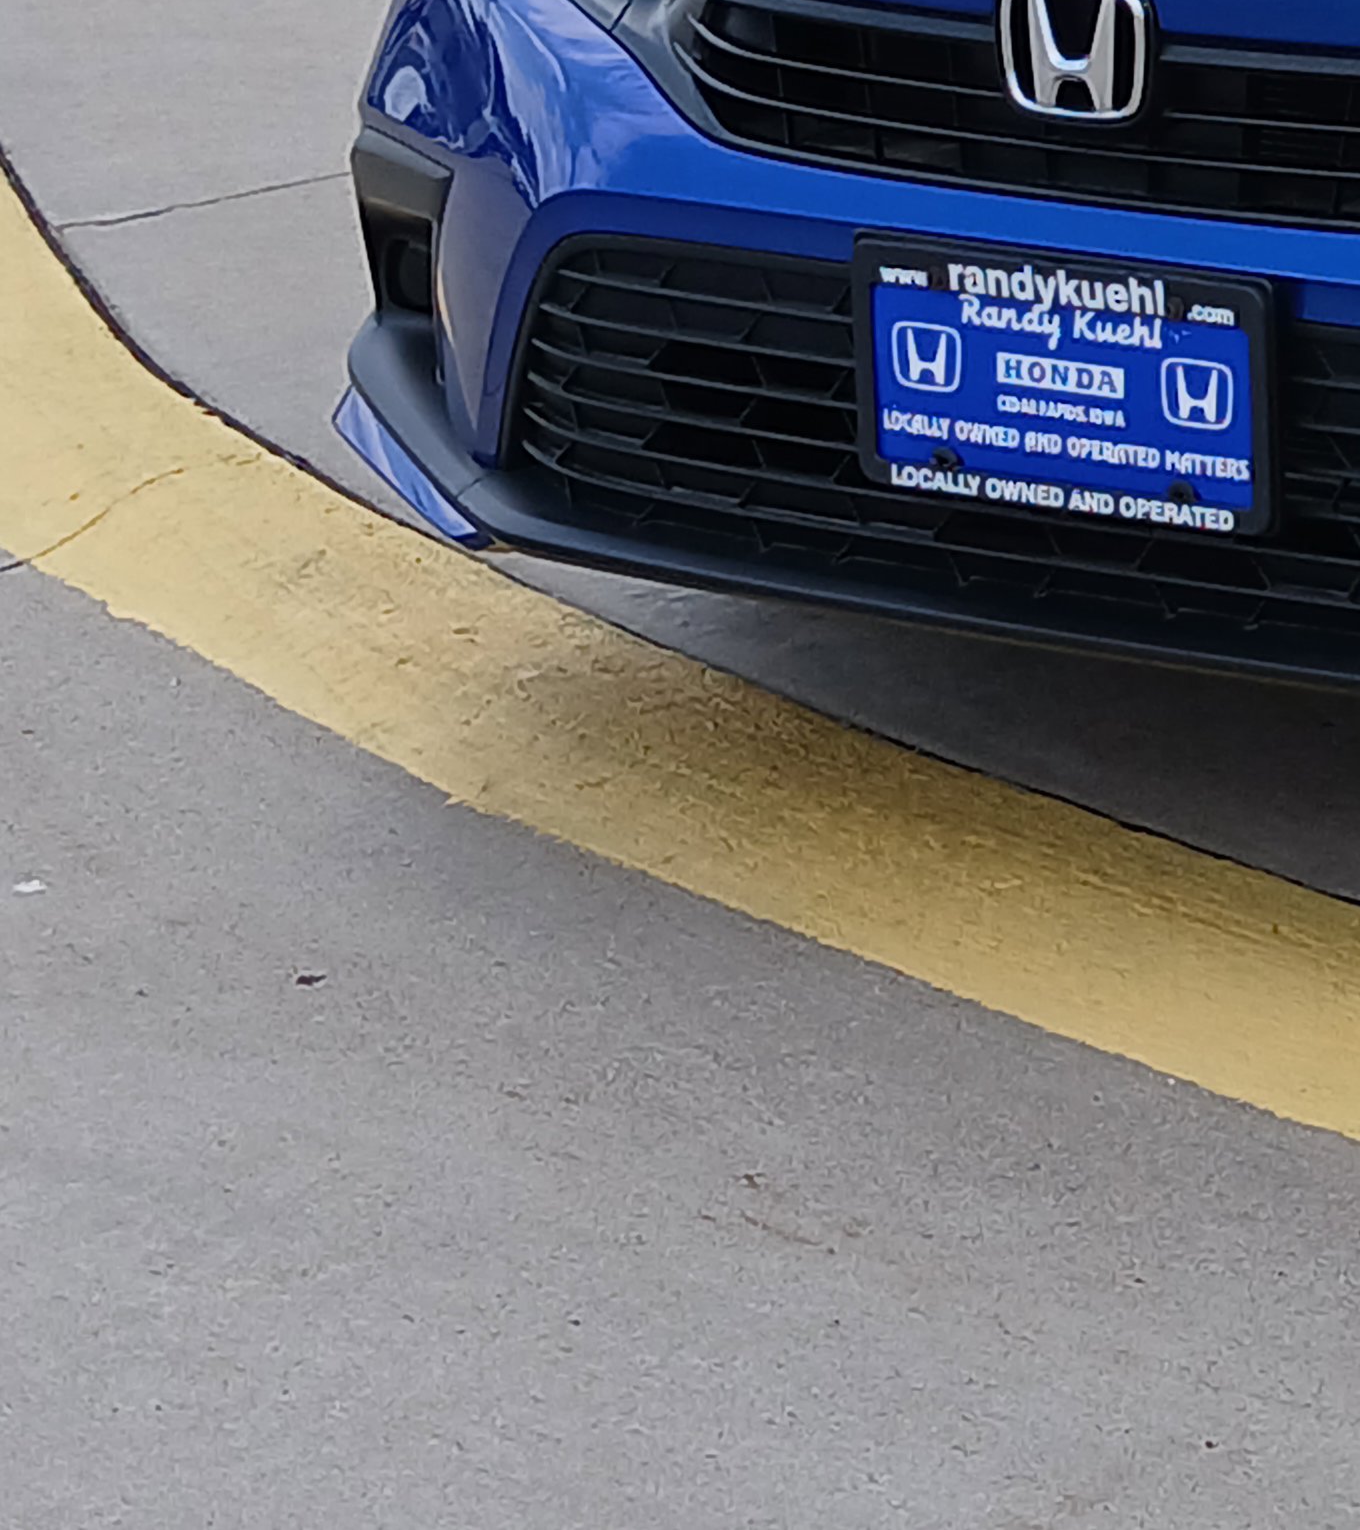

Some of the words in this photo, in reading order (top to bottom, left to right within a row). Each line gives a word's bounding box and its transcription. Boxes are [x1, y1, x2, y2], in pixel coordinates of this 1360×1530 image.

[947, 263, 1166, 317] randykuehl
[958, 293, 1061, 351] Randy
[1072, 309, 1163, 349] Kuehl
[1003, 358, 1118, 394] HONDA
[883, 407, 950, 440] LOCALLY
[954, 420, 1020, 448] OWNED
[1066, 436, 1161, 469] OPERATED
[1165, 450, 1250, 482] MATTERS
[891, 462, 981, 497] LOCALLY
[985, 477, 1065, 508] OWNED
[1067, 488, 1115, 516] AND
[1119, 495, 1235, 532] OPERATED
